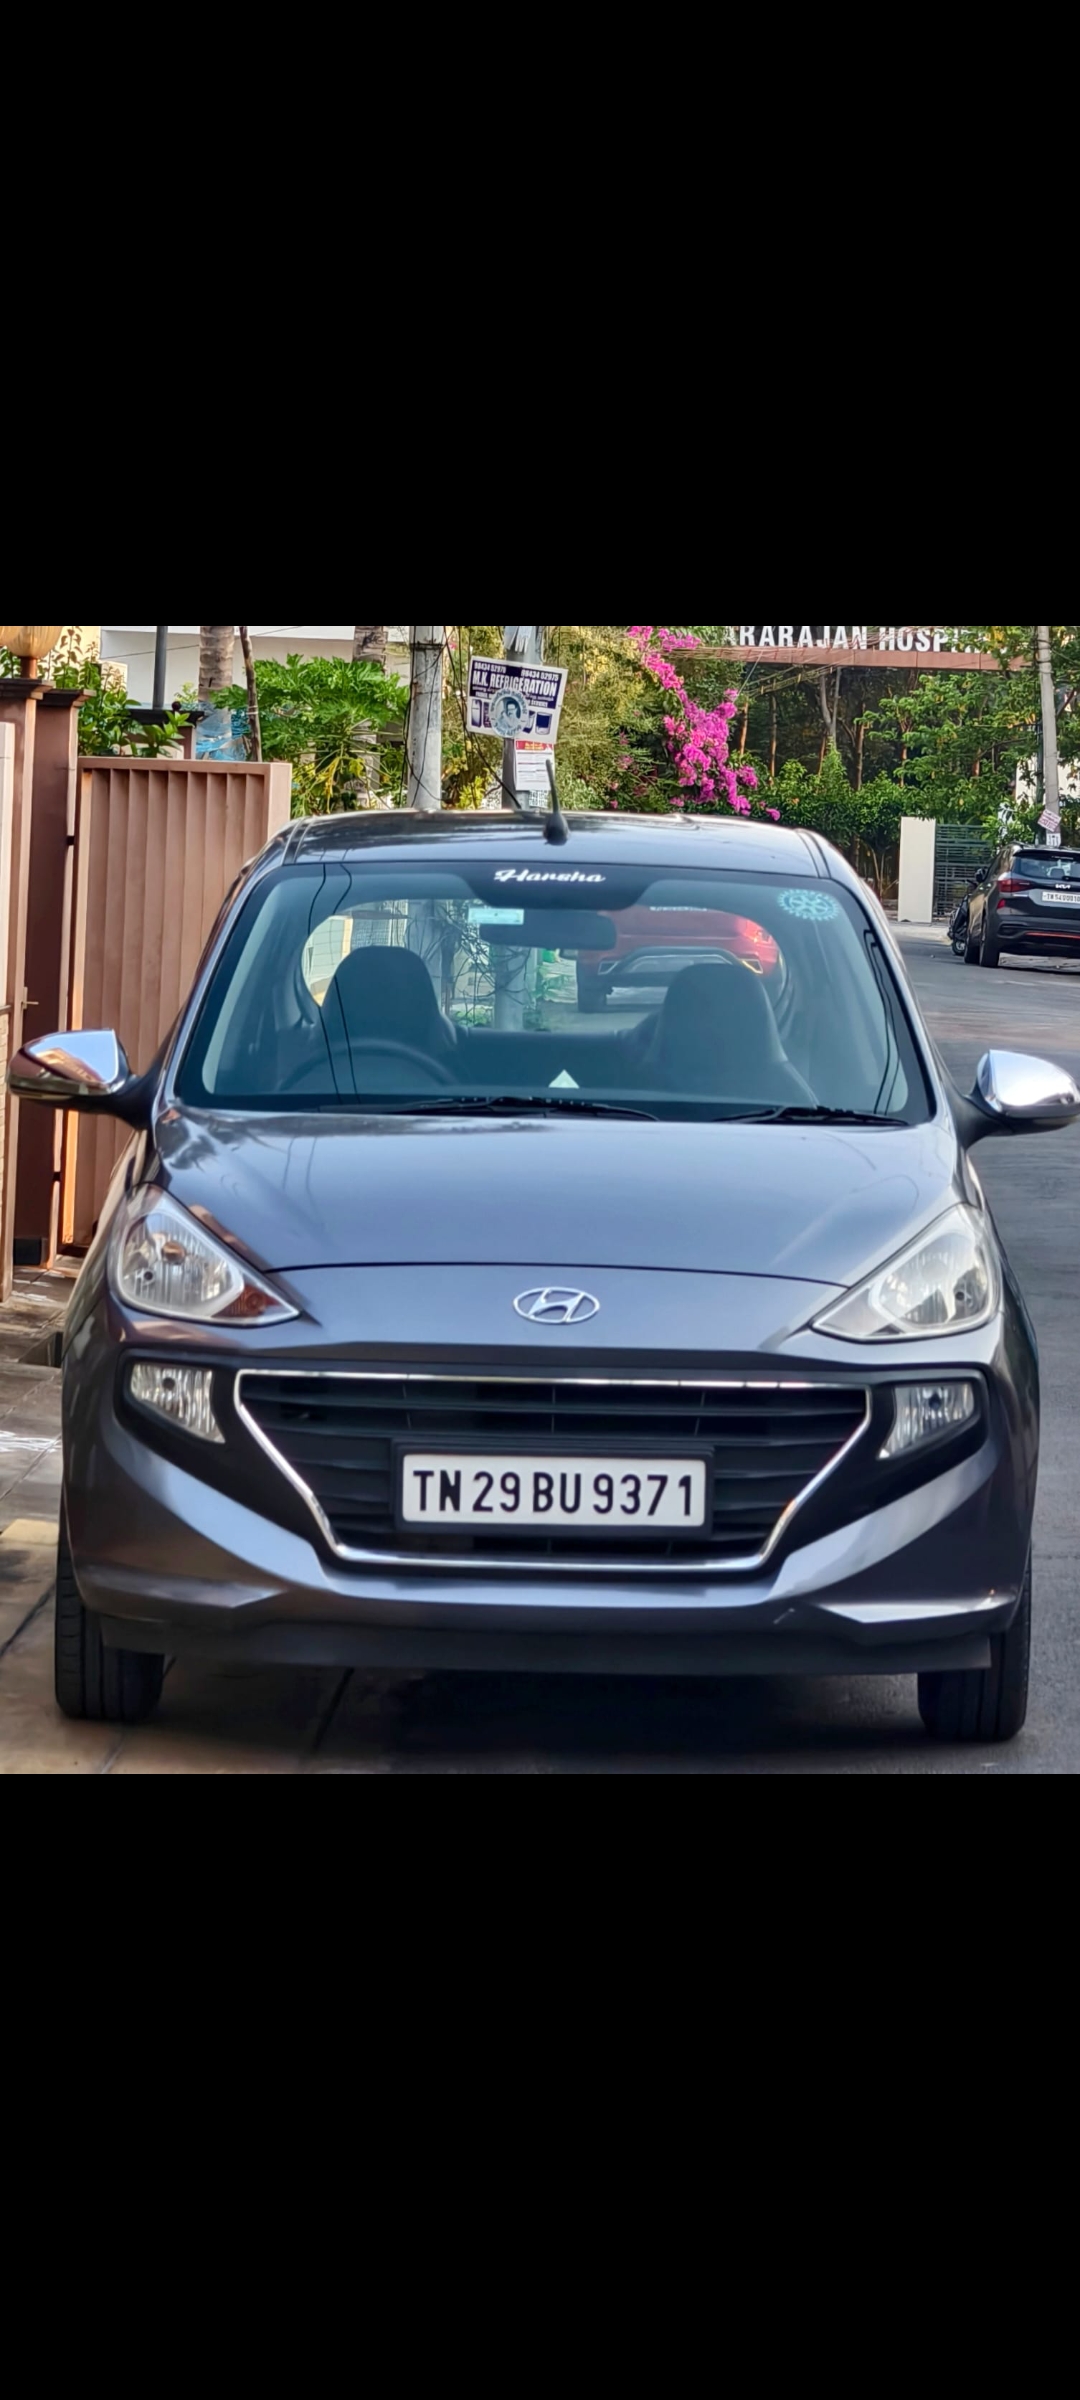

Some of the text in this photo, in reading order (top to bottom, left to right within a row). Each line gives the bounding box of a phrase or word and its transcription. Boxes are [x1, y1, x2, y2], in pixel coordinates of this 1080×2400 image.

[489, 674, 558, 697] REFRIGERATION
[412, 1470, 692, 1517] TN 29 BU 9371
